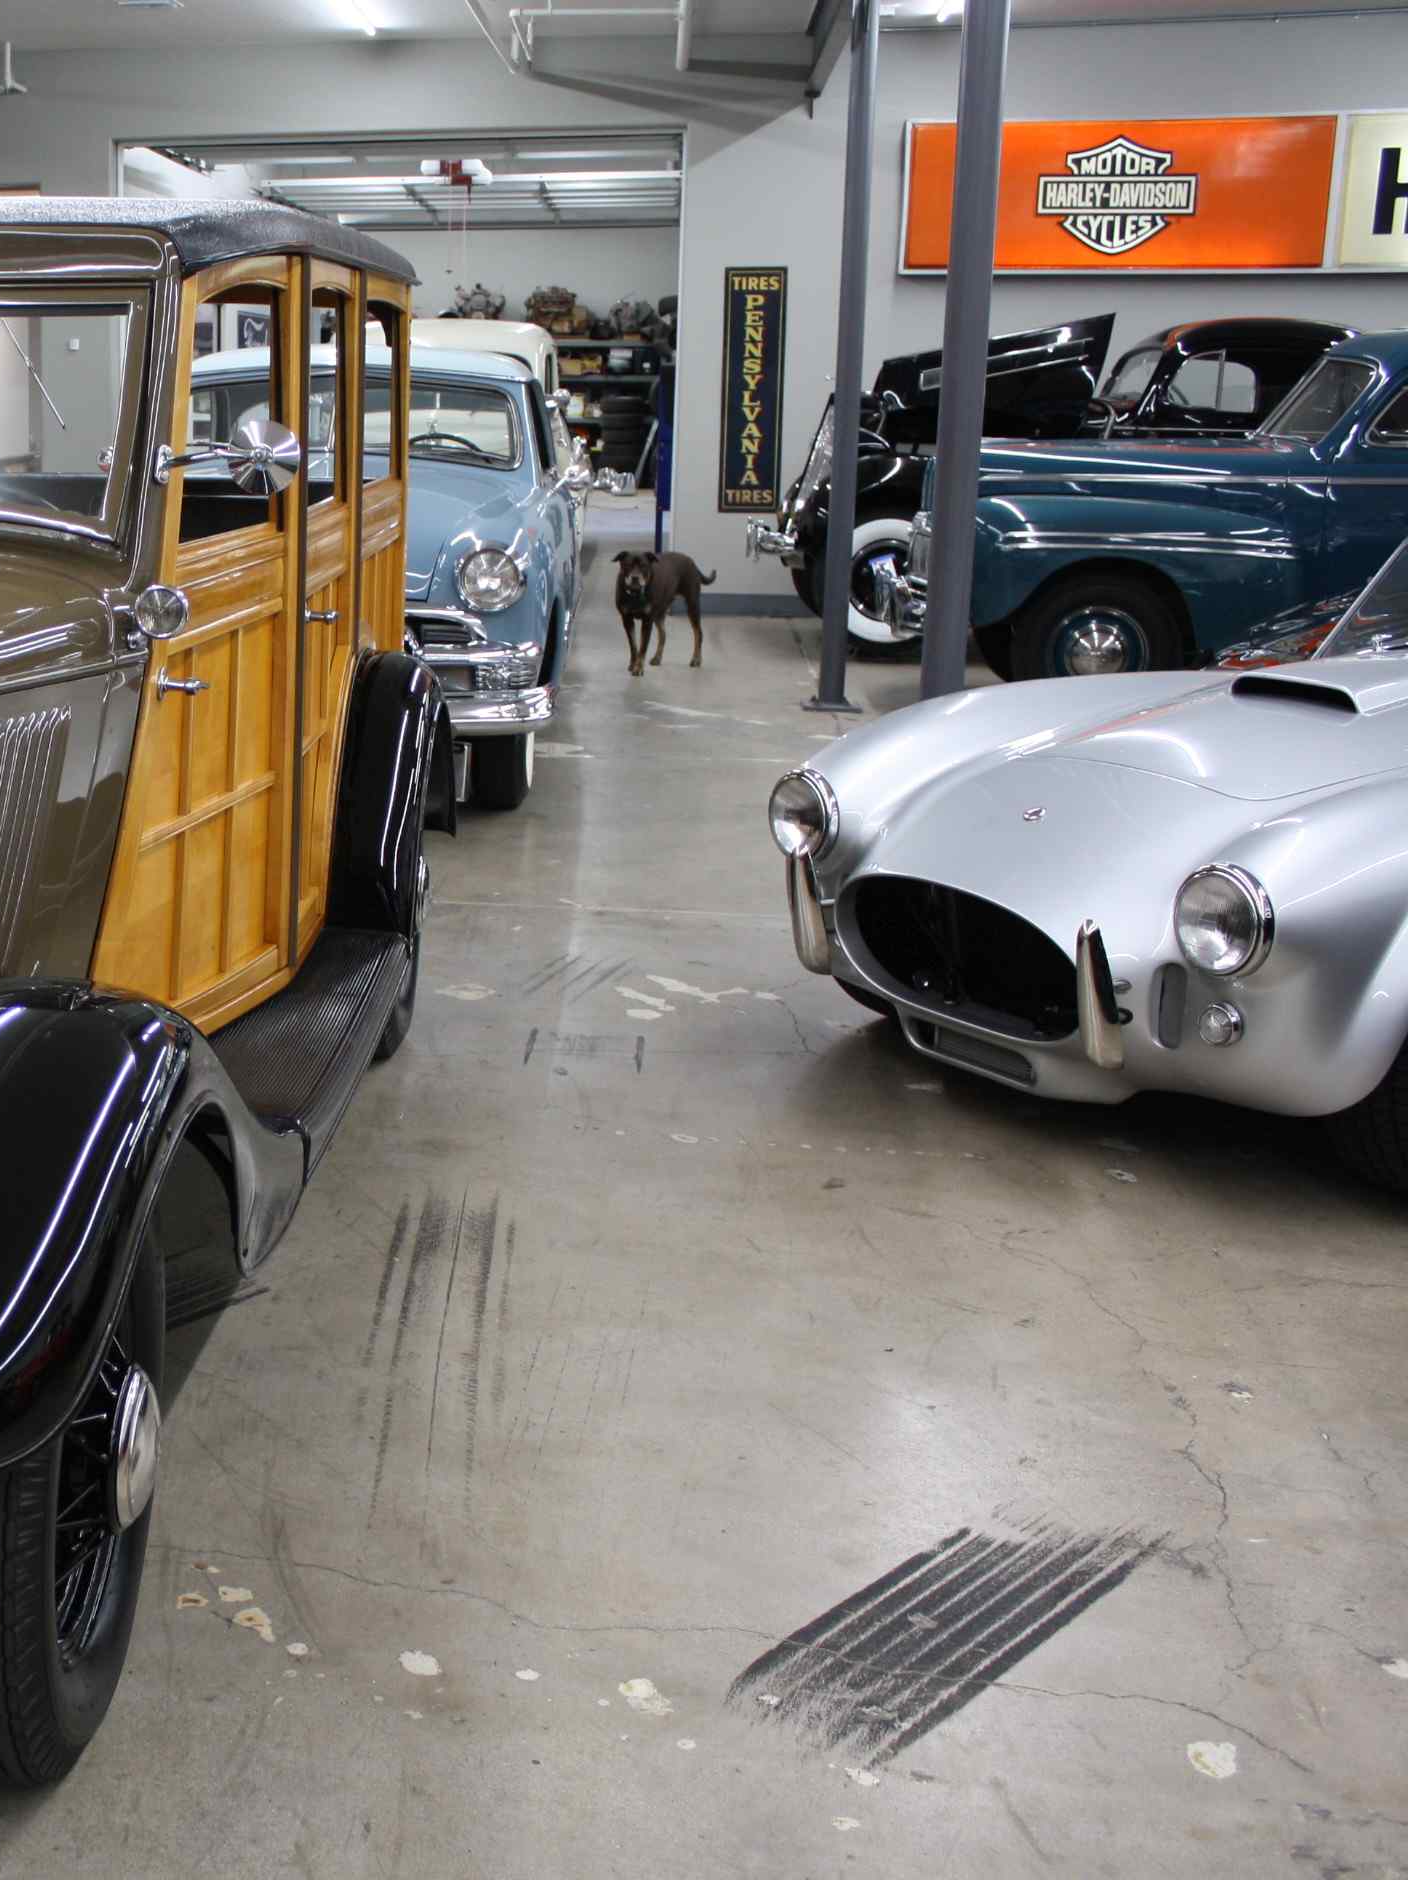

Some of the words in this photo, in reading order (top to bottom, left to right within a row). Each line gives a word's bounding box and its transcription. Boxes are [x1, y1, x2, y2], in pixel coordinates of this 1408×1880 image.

[1080, 147, 1156, 175] MOTOR
[1045, 182, 1189, 208] HARLEY-DAVIDSON
[1075, 215, 1153, 249] CYCLES
[732, 276, 781, 291] TIRES
[739, 293, 766, 486] PENNSYLVANIA
[725, 489, 774, 505] TIRES
